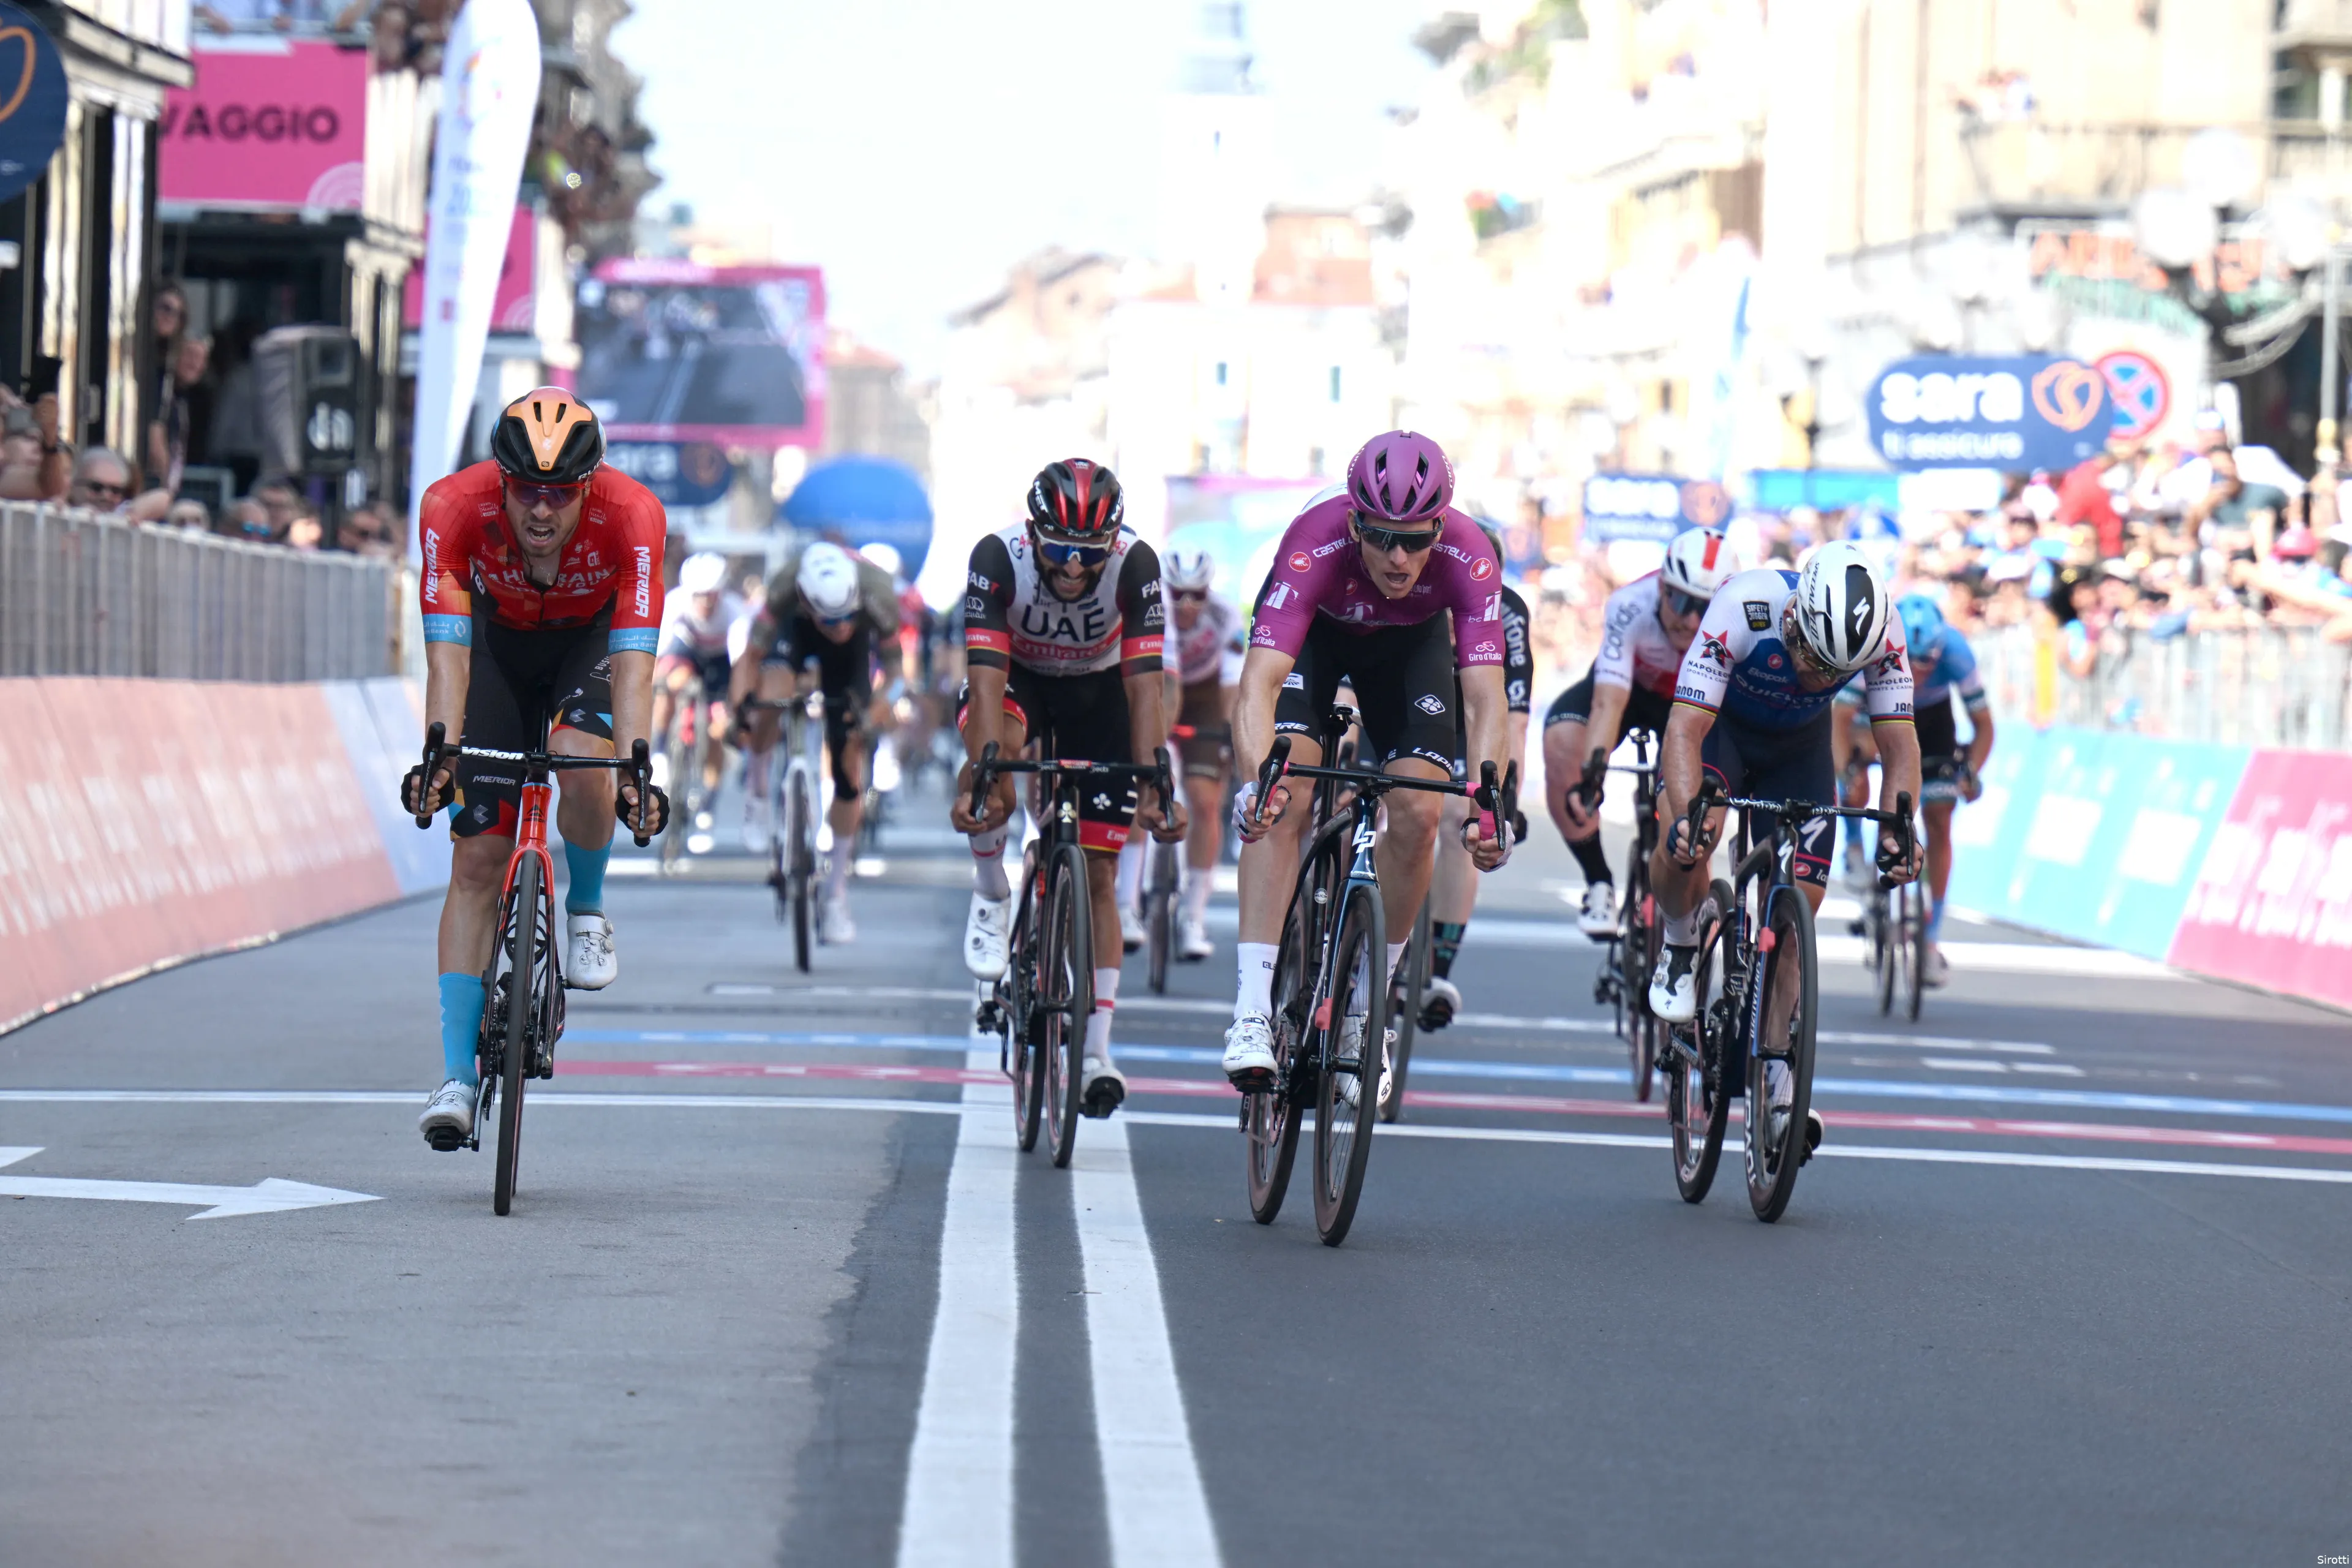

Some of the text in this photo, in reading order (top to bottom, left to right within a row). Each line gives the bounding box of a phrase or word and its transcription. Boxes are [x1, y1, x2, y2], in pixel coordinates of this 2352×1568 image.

[1880, 372, 2024, 423] sara
[1114, 540, 1128, 557] 42
[1312, 536, 1354, 558] CASTELL
[425, 527, 440, 605] MERIDA
[634, 546, 650, 618] MERIDA
[968, 571, 990, 591] AB
[1746, 604, 1768, 612] SAFETY
[1749, 612, 1768, 620] JOGGER
[1021, 604, 1107, 643] UAE
[1256, 635, 1276, 647] d'Italia
[1468, 651, 1502, 662] Giro d'Italia
[1686, 668, 1708, 679] SPORTS
[1687, 660, 1728, 678] NAPOLEO
[1747, 666, 1789, 684] Ekopak
[473, 775, 516, 786] MERIDA
[1816, 869, 1828, 882] la
[1381, 1080, 1392, 1100] SIDI
